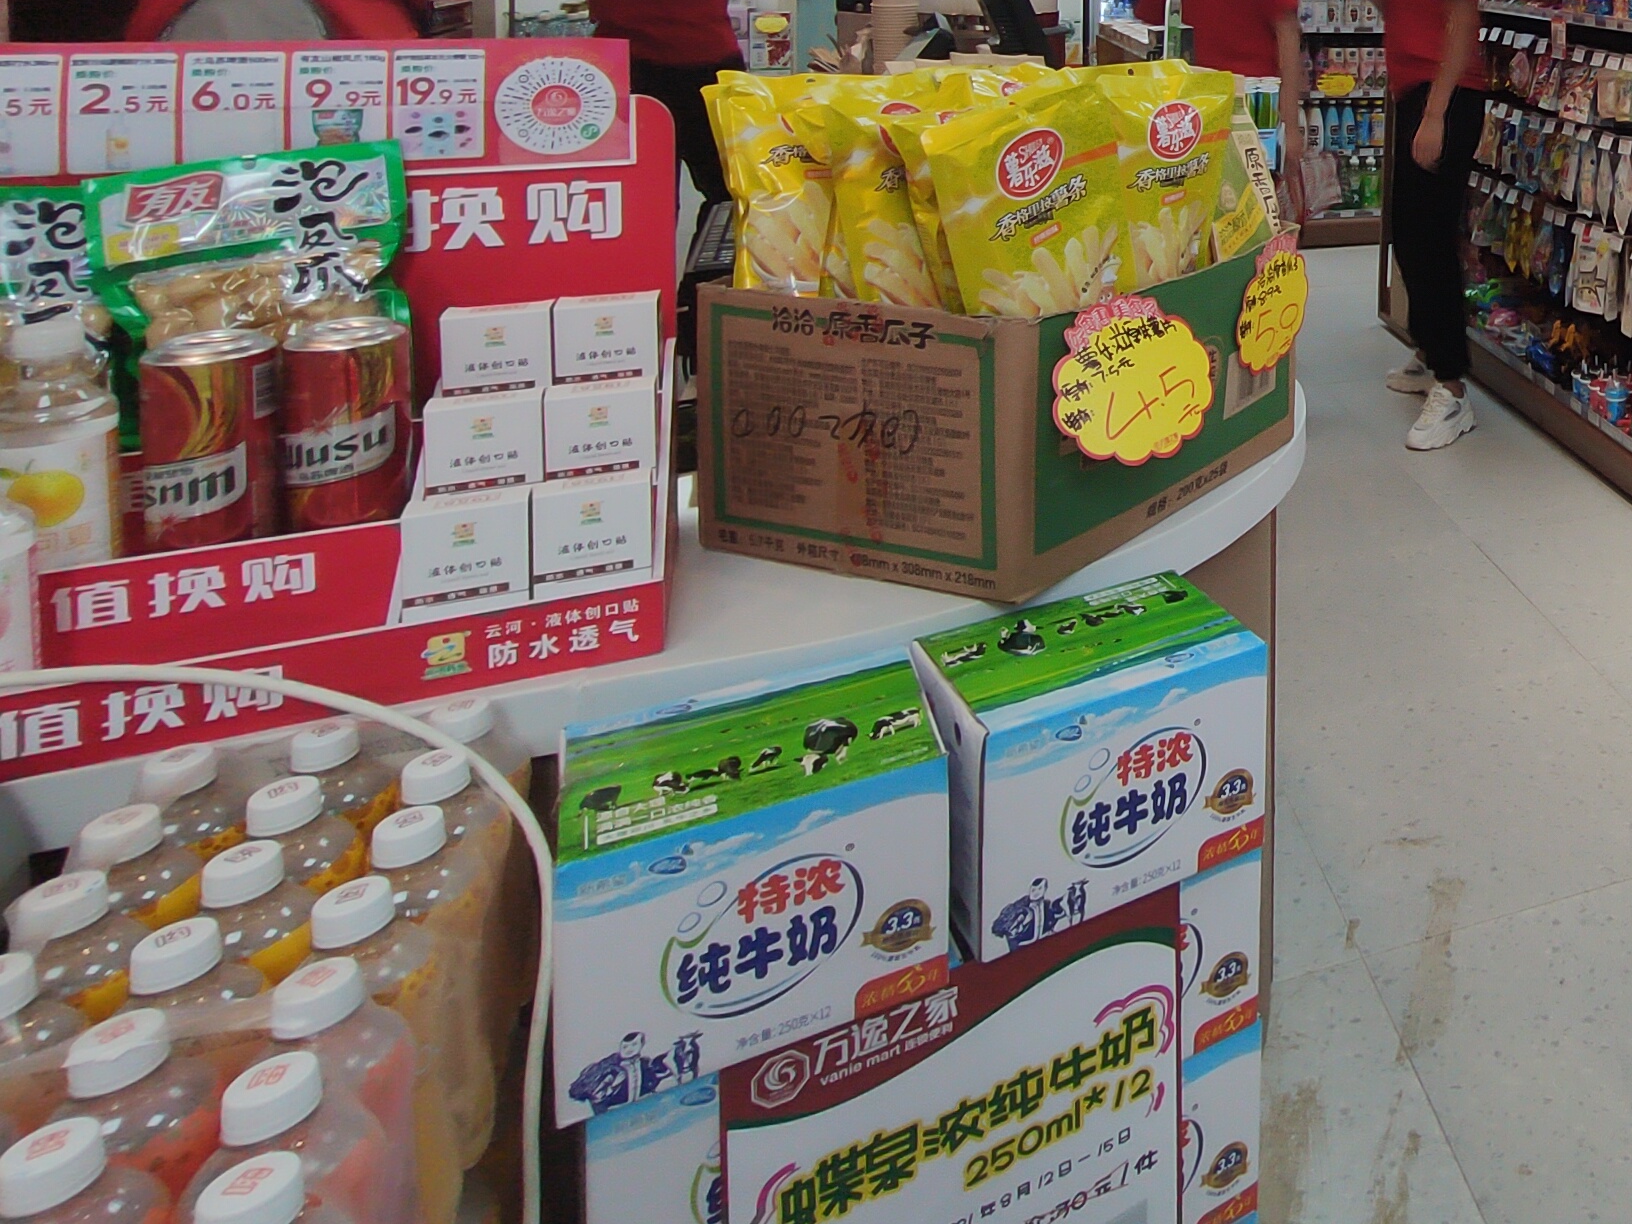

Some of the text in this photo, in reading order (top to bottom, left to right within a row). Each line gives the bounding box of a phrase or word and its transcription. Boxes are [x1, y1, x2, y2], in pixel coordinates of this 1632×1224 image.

[79, 83, 168, 115] 2.5元
[191, 81, 276, 112] 6.0元
[305, 79, 381, 108] 9.9元
[396, 77, 477, 106] 19.9元
[135, 179, 211, 221] 有友
[989, 174, 1088, 242] 香格里拉薯条
[771, 306, 936, 350] 洽洽 原香瓜子
[50, 553, 316, 633] 值换购
[487, 619, 640, 669] 防水透气
[1117, 731, 1194, 786] 特浓
[1071, 772, 1188, 855] 纯牛奶
[737, 857, 846, 924] 特浓
[676, 905, 839, 1005] 纯牛奶
[813, 985, 959, 1076] 万逸之家
[866, 1045, 900, 1068] mart
